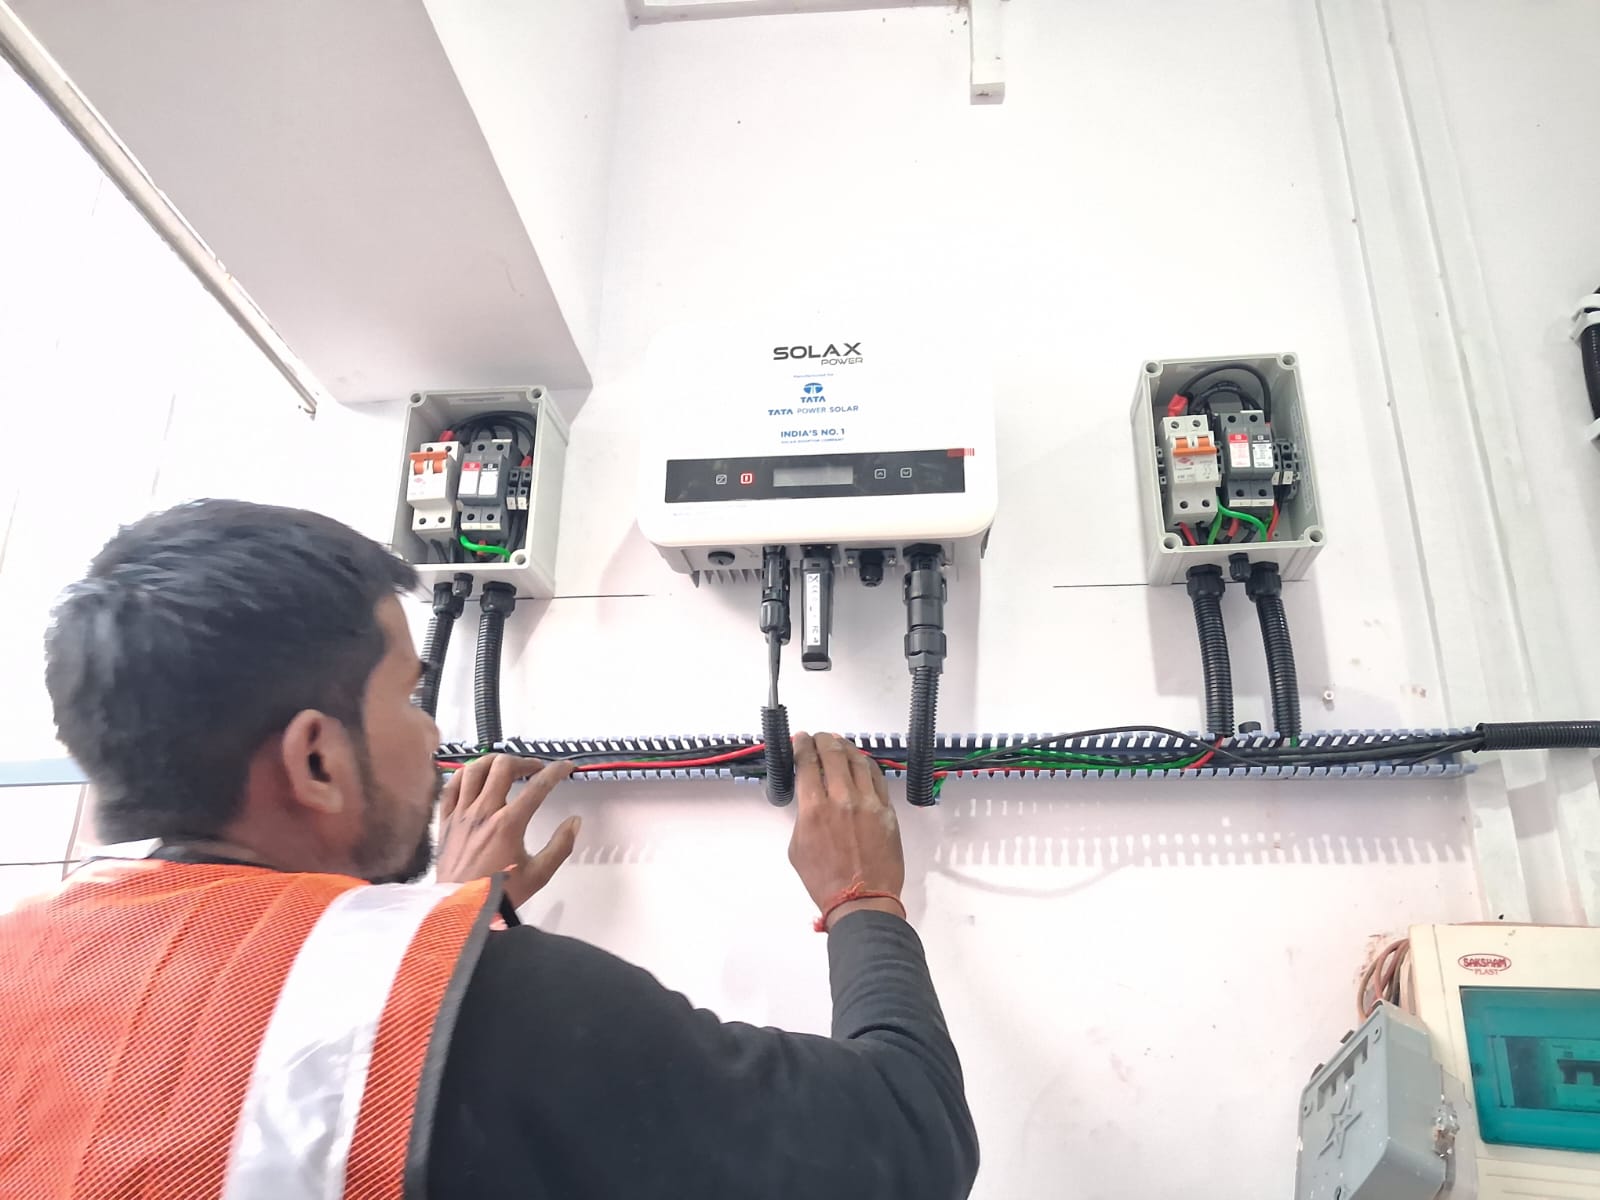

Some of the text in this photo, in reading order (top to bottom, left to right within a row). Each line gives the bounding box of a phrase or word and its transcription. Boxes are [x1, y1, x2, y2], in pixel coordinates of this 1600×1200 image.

[773, 342, 861, 360] SOLAX
[821, 357, 863, 366] POWER
[829, 405, 859, 413] SOLAR
[780, 430, 818, 438] INDIA'S
[821, 428, 839, 436] NO.
[1463, 957, 1507, 968] SAKSHAM
